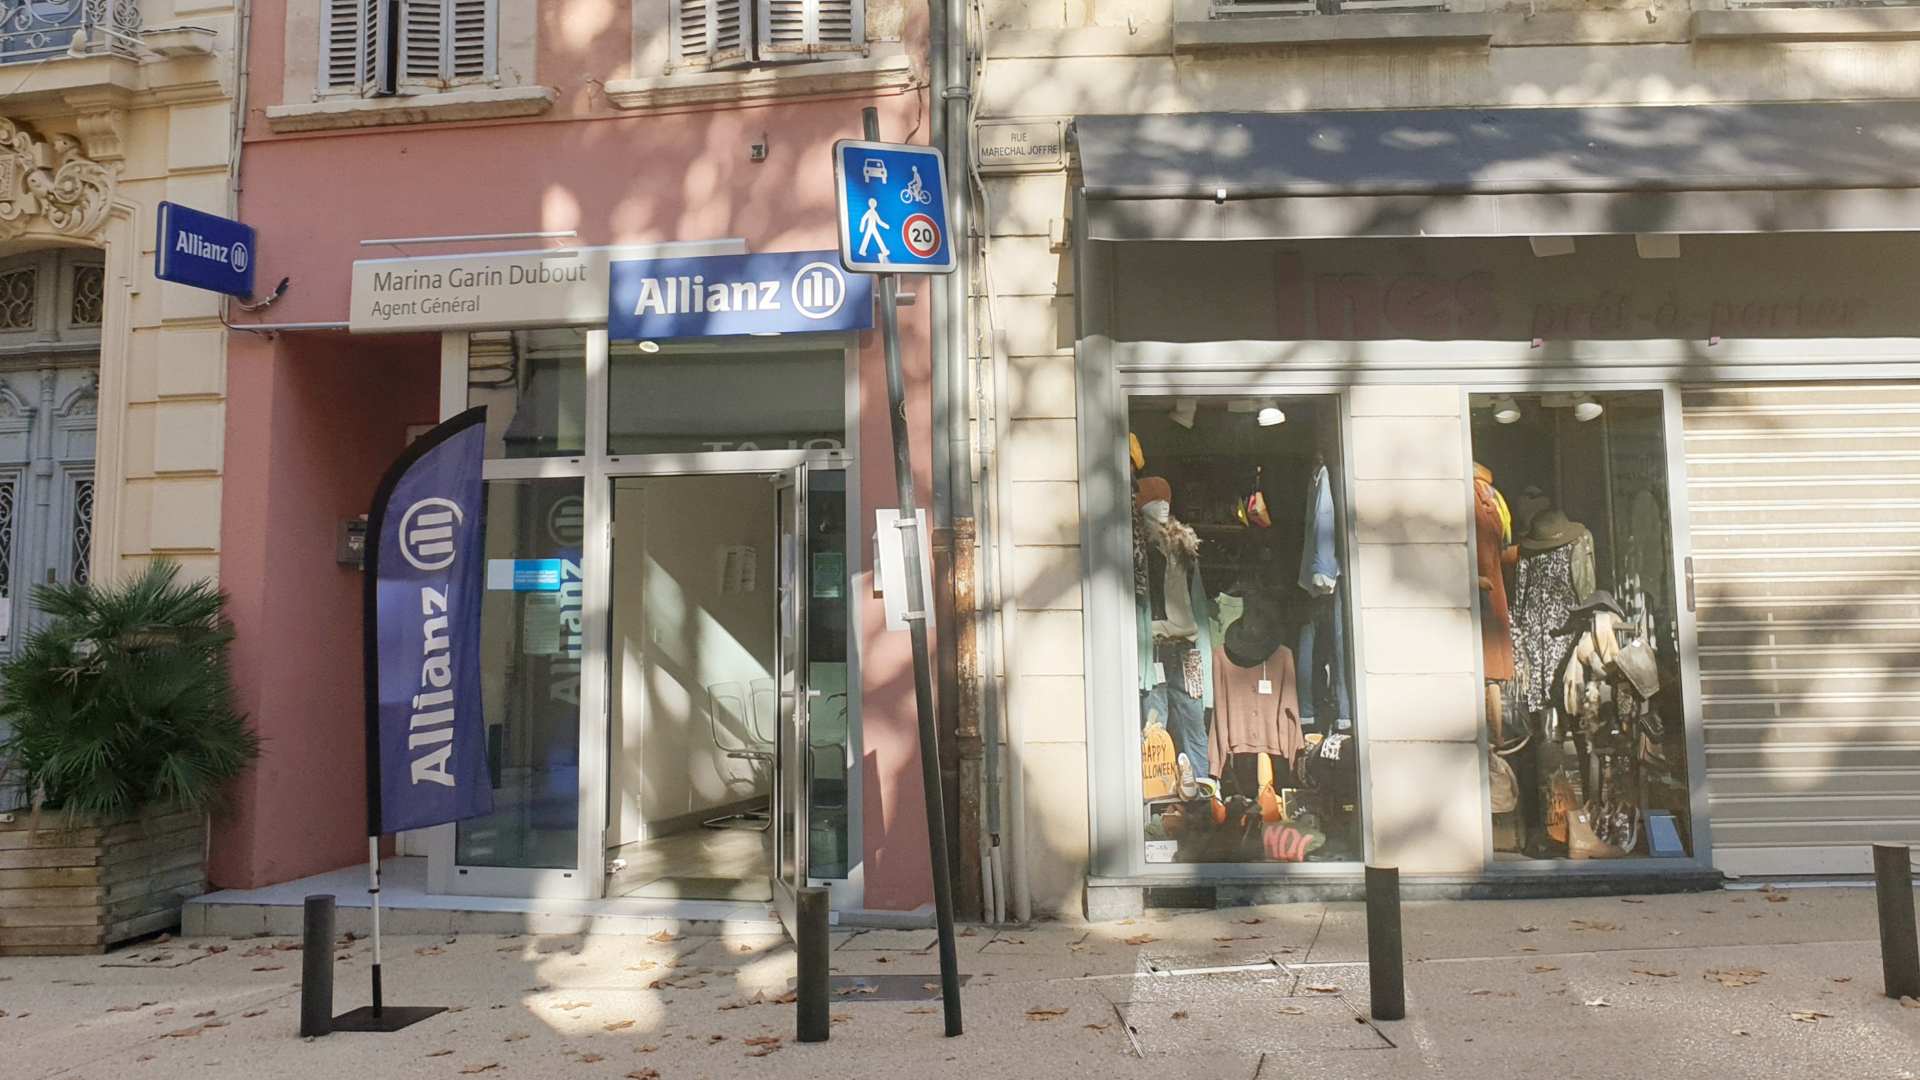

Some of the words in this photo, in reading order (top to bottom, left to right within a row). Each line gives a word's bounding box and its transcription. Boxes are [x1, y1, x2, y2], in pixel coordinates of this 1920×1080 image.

[981, 146, 1026, 157] MARECHAL
[1027, 145, 1058, 155] JOFFRE
[1011, 133, 1027, 142] RUE
[175, 230, 229, 263] Allianz
[912, 228, 932, 243] 20
[373, 269, 442, 292] Marina
[448, 265, 503, 288] Garin
[509, 262, 587, 285] Dubout
[371, 299, 417, 320] Agent
[420, 295, 480, 314] Général
[633, 275, 782, 315] Allianz
[408, 584, 456, 787] Allianz
